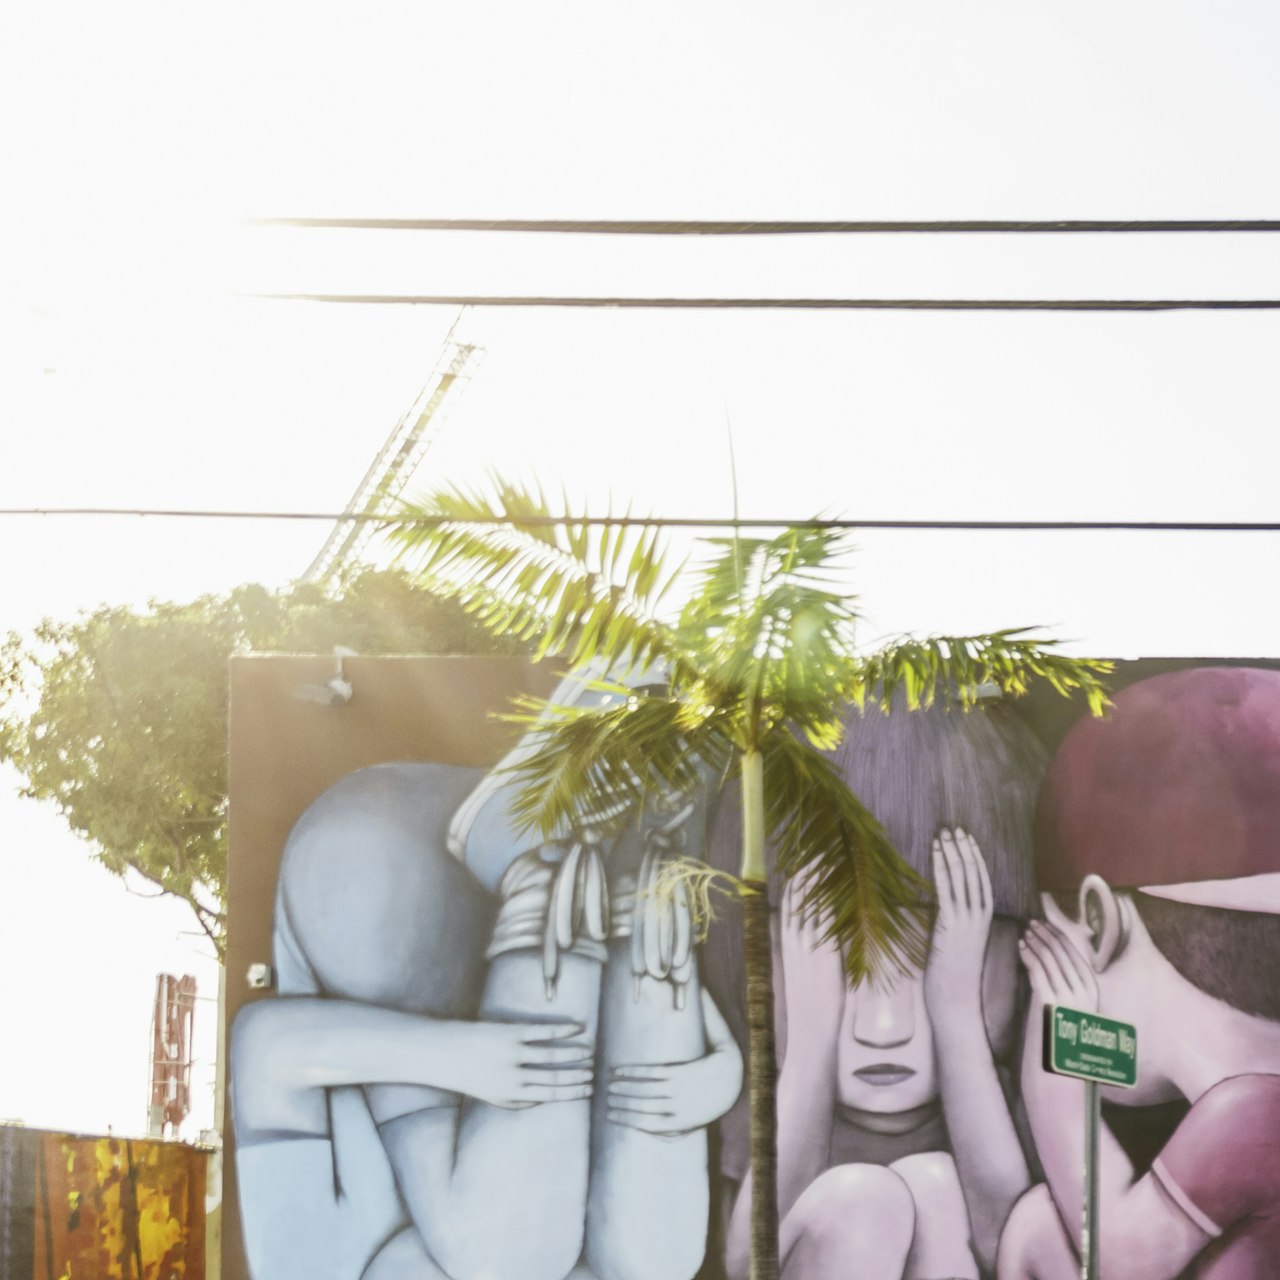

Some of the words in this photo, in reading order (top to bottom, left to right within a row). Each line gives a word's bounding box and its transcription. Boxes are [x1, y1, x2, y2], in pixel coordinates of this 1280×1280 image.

[1057, 1012, 1078, 1046] Tony
[1081, 1019, 1117, 1050] Goldman
[1119, 1029, 1135, 1059] Way
